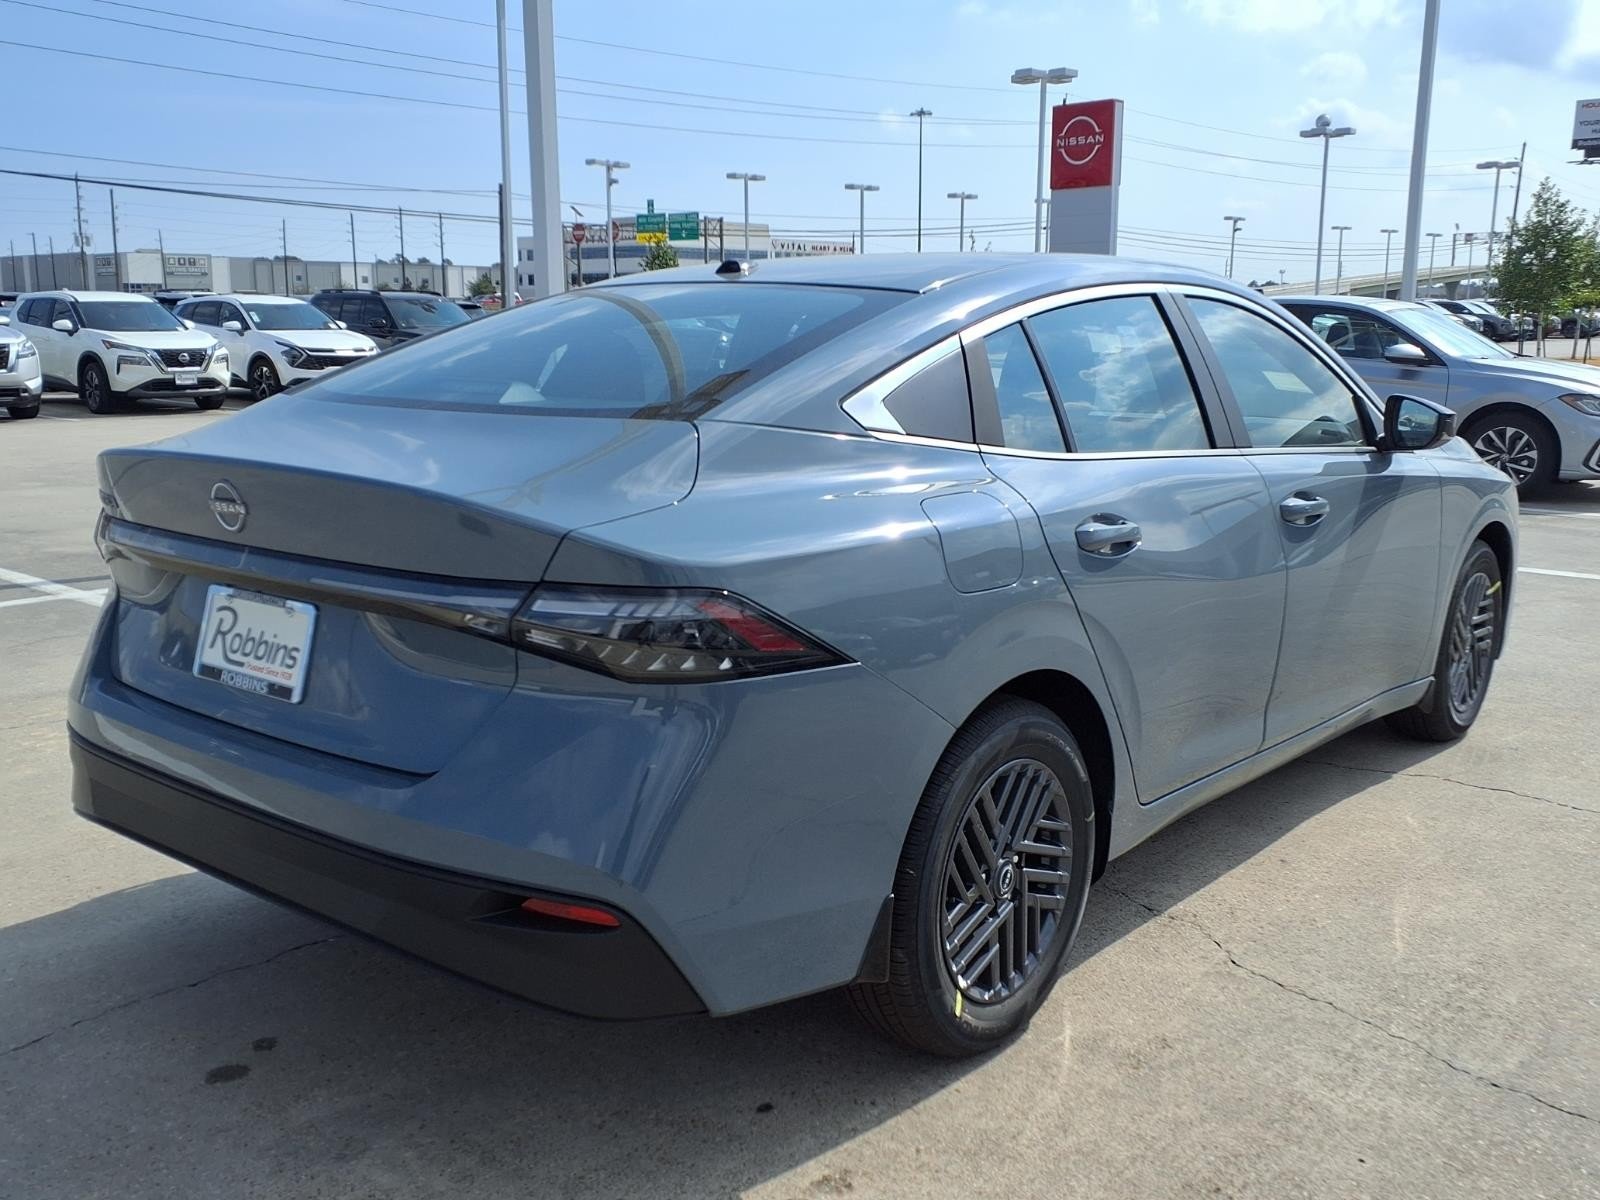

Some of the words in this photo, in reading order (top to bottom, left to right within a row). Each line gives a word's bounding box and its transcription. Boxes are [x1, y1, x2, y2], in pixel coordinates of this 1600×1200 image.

[1056, 134, 1104, 147] NISSAN
[780, 242, 807, 251] VITAL
[209, 500, 245, 514] SSAN
[209, 605, 301, 669] Robbins
[220, 670, 269, 694] ROBBINS
